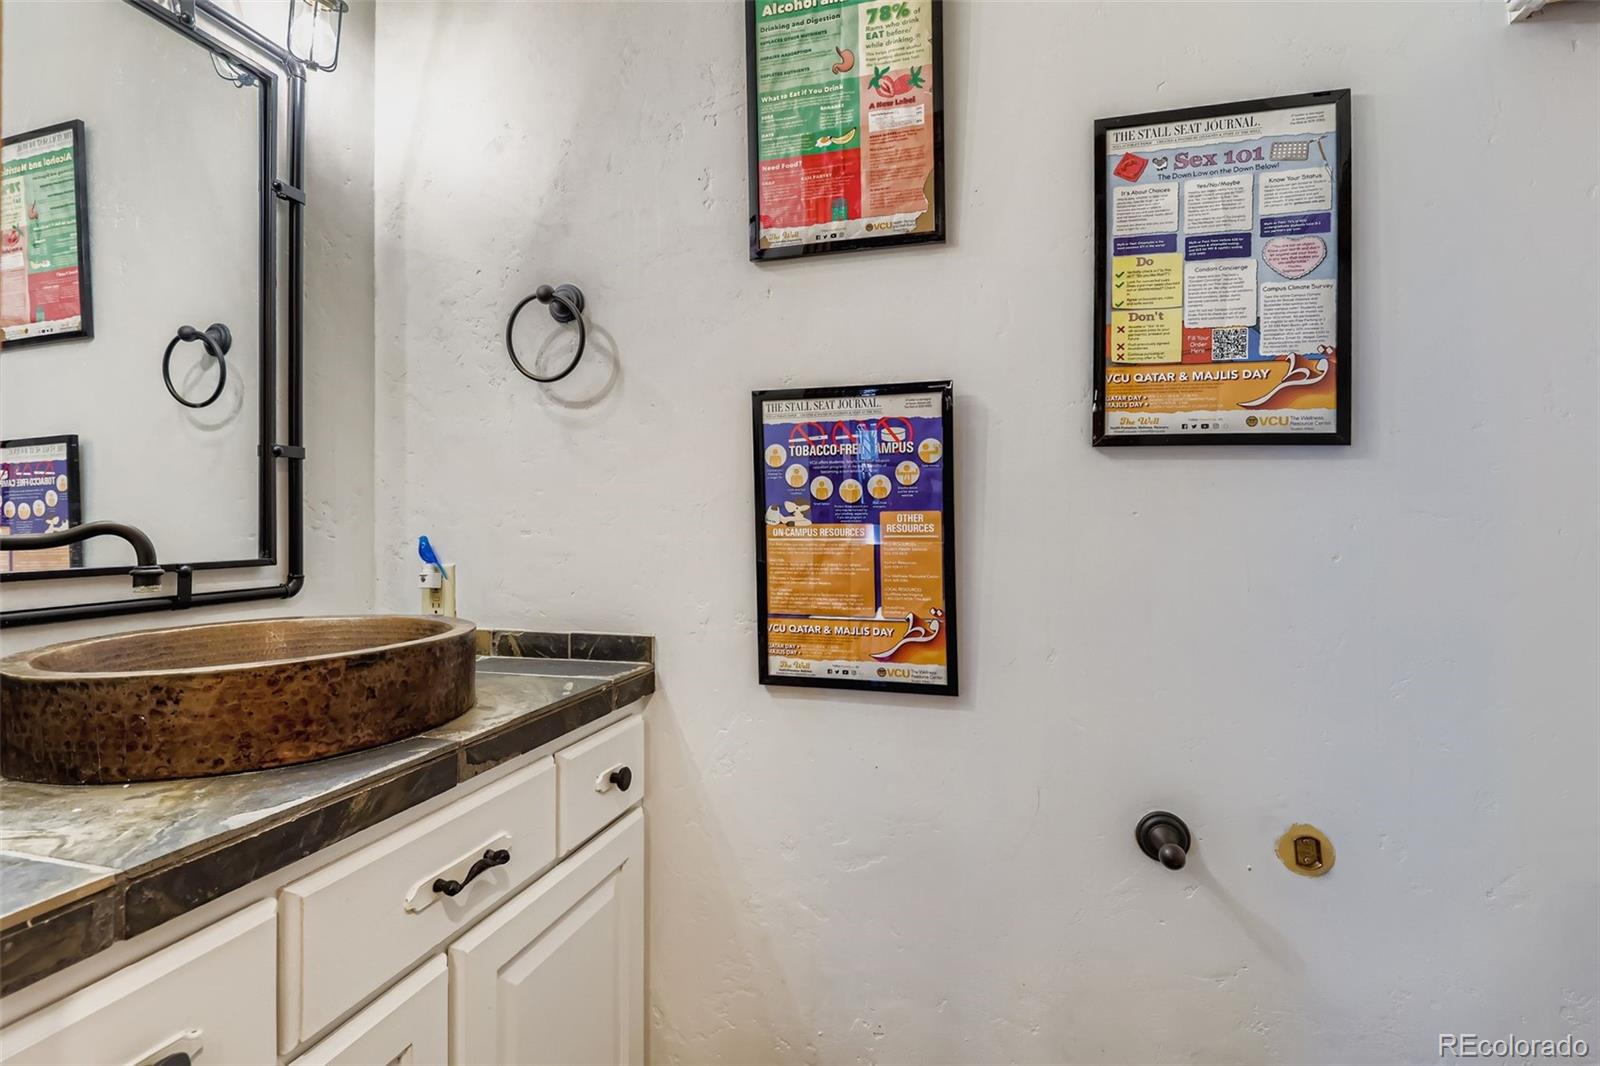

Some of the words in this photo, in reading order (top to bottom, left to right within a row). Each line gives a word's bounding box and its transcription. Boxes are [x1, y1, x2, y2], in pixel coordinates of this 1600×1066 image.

[762, 0, 817, 17] Alcohol
[866, 1, 910, 25] 78%
[760, 23, 790, 33] Drinking
[792, 20, 805, 28] and
[807, 14, 841, 25] Digestion
[886, 21, 901, 29] who
[902, 16, 920, 25] drink
[866, 30, 885, 40] EAT
[761, 94, 780, 103] What
[789, 90, 801, 98] Eat
[801, 88, 807, 96] if
[808, 87, 823, 95] You
[824, 83, 844, 92] Drink
[895, 96, 916, 105] Label
[1113, 131, 1136, 143] THE
[1137, 126, 1171, 140] STALL
[1174, 122, 1202, 136] SEAT
[1173, 150, 1217, 171] Sex
[1223, 146, 1265, 165] 101
[762, 162, 780, 171] Need
[782, 160, 803, 169] Food?
[1157, 172, 1171, 181] The
[1172, 169, 1191, 180] Down
[1193, 169, 1208, 178] Low
[1209, 168, 1219, 176] on
[1220, 165, 1232, 175] the
[1233, 163, 1254, 173] Down
[1255, 161, 1280, 171] Below!
[1301, 172, 1322, 180] Status
[1148, 186, 1171, 194] Choices
[1197, 180, 1241, 189] Yes/No/Maybe
[874, 221, 893, 231] VCU
[1136, 257, 1154, 267] Do
[1194, 265, 1218, 273] Condom
[1218, 264, 1248, 273] Concierge
[1311, 281, 1334, 290] Survey
[1128, 311, 1164, 322] Don't
[1106, 373, 1130, 384] VCU
[1133, 372, 1176, 384] QATAR
[1179, 371, 1189, 382] &
[1192, 369, 1239, 382] MAJLIS
[1242, 368, 1271, 381] DAY
[767, 402, 783, 413] THE
[785, 402, 811, 412] STALL
[813, 399, 835, 411] SEAT
[1129, 401, 1144, 409] DAY
[1259, 415, 1289, 427] VCU
[789, 443, 863, 457] TOBACCO-FRE
[896, 513, 924, 523] OTHER
[820, 528, 866, 537] RESOURCES
[886, 523, 936, 534] RESOURCES
[768, 624, 787, 633] VCU
[789, 624, 821, 634] QATAR
[824, 626, 833, 635] &
[835, 626, 870, 637] MAJLIS
[872, 627, 895, 637] DAY
[887, 668, 910, 679] VCU
